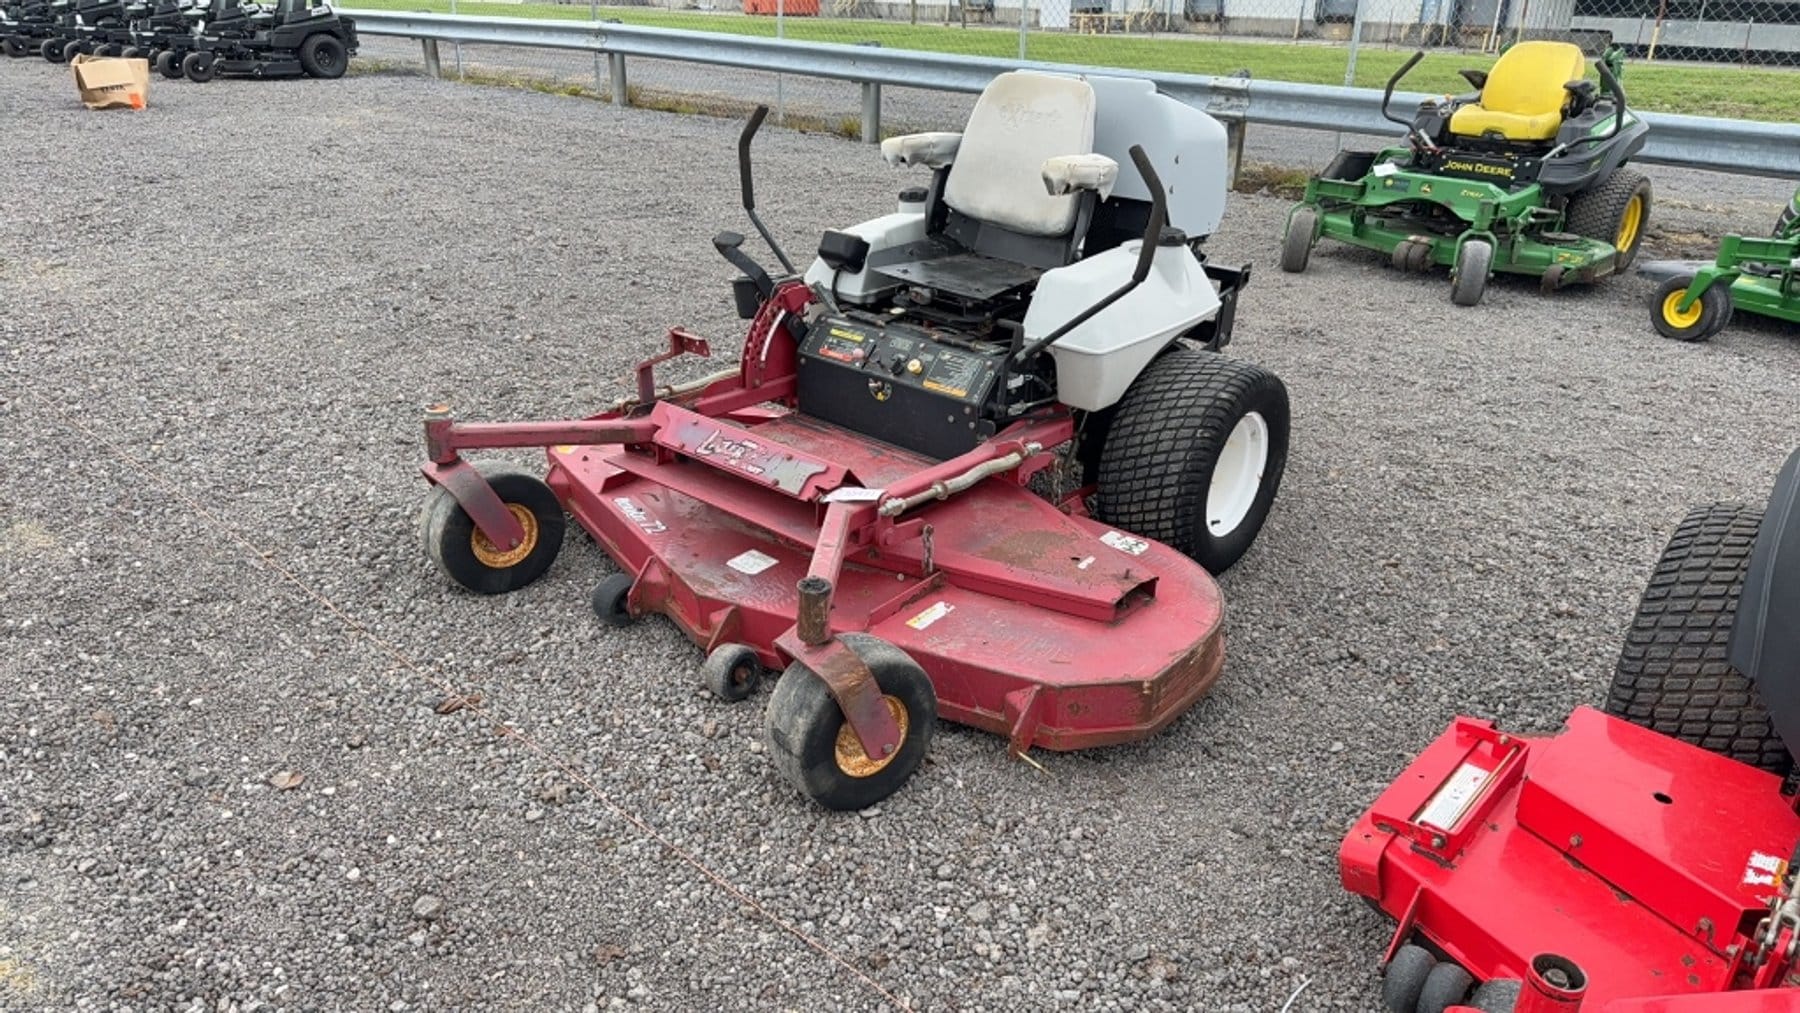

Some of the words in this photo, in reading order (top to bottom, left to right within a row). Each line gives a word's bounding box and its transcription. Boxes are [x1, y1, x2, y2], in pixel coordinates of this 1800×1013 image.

[1443, 160, 1473, 172] JOHN
[1474, 163, 1513, 177] DEERE
[639, 520, 667, 535] 72
